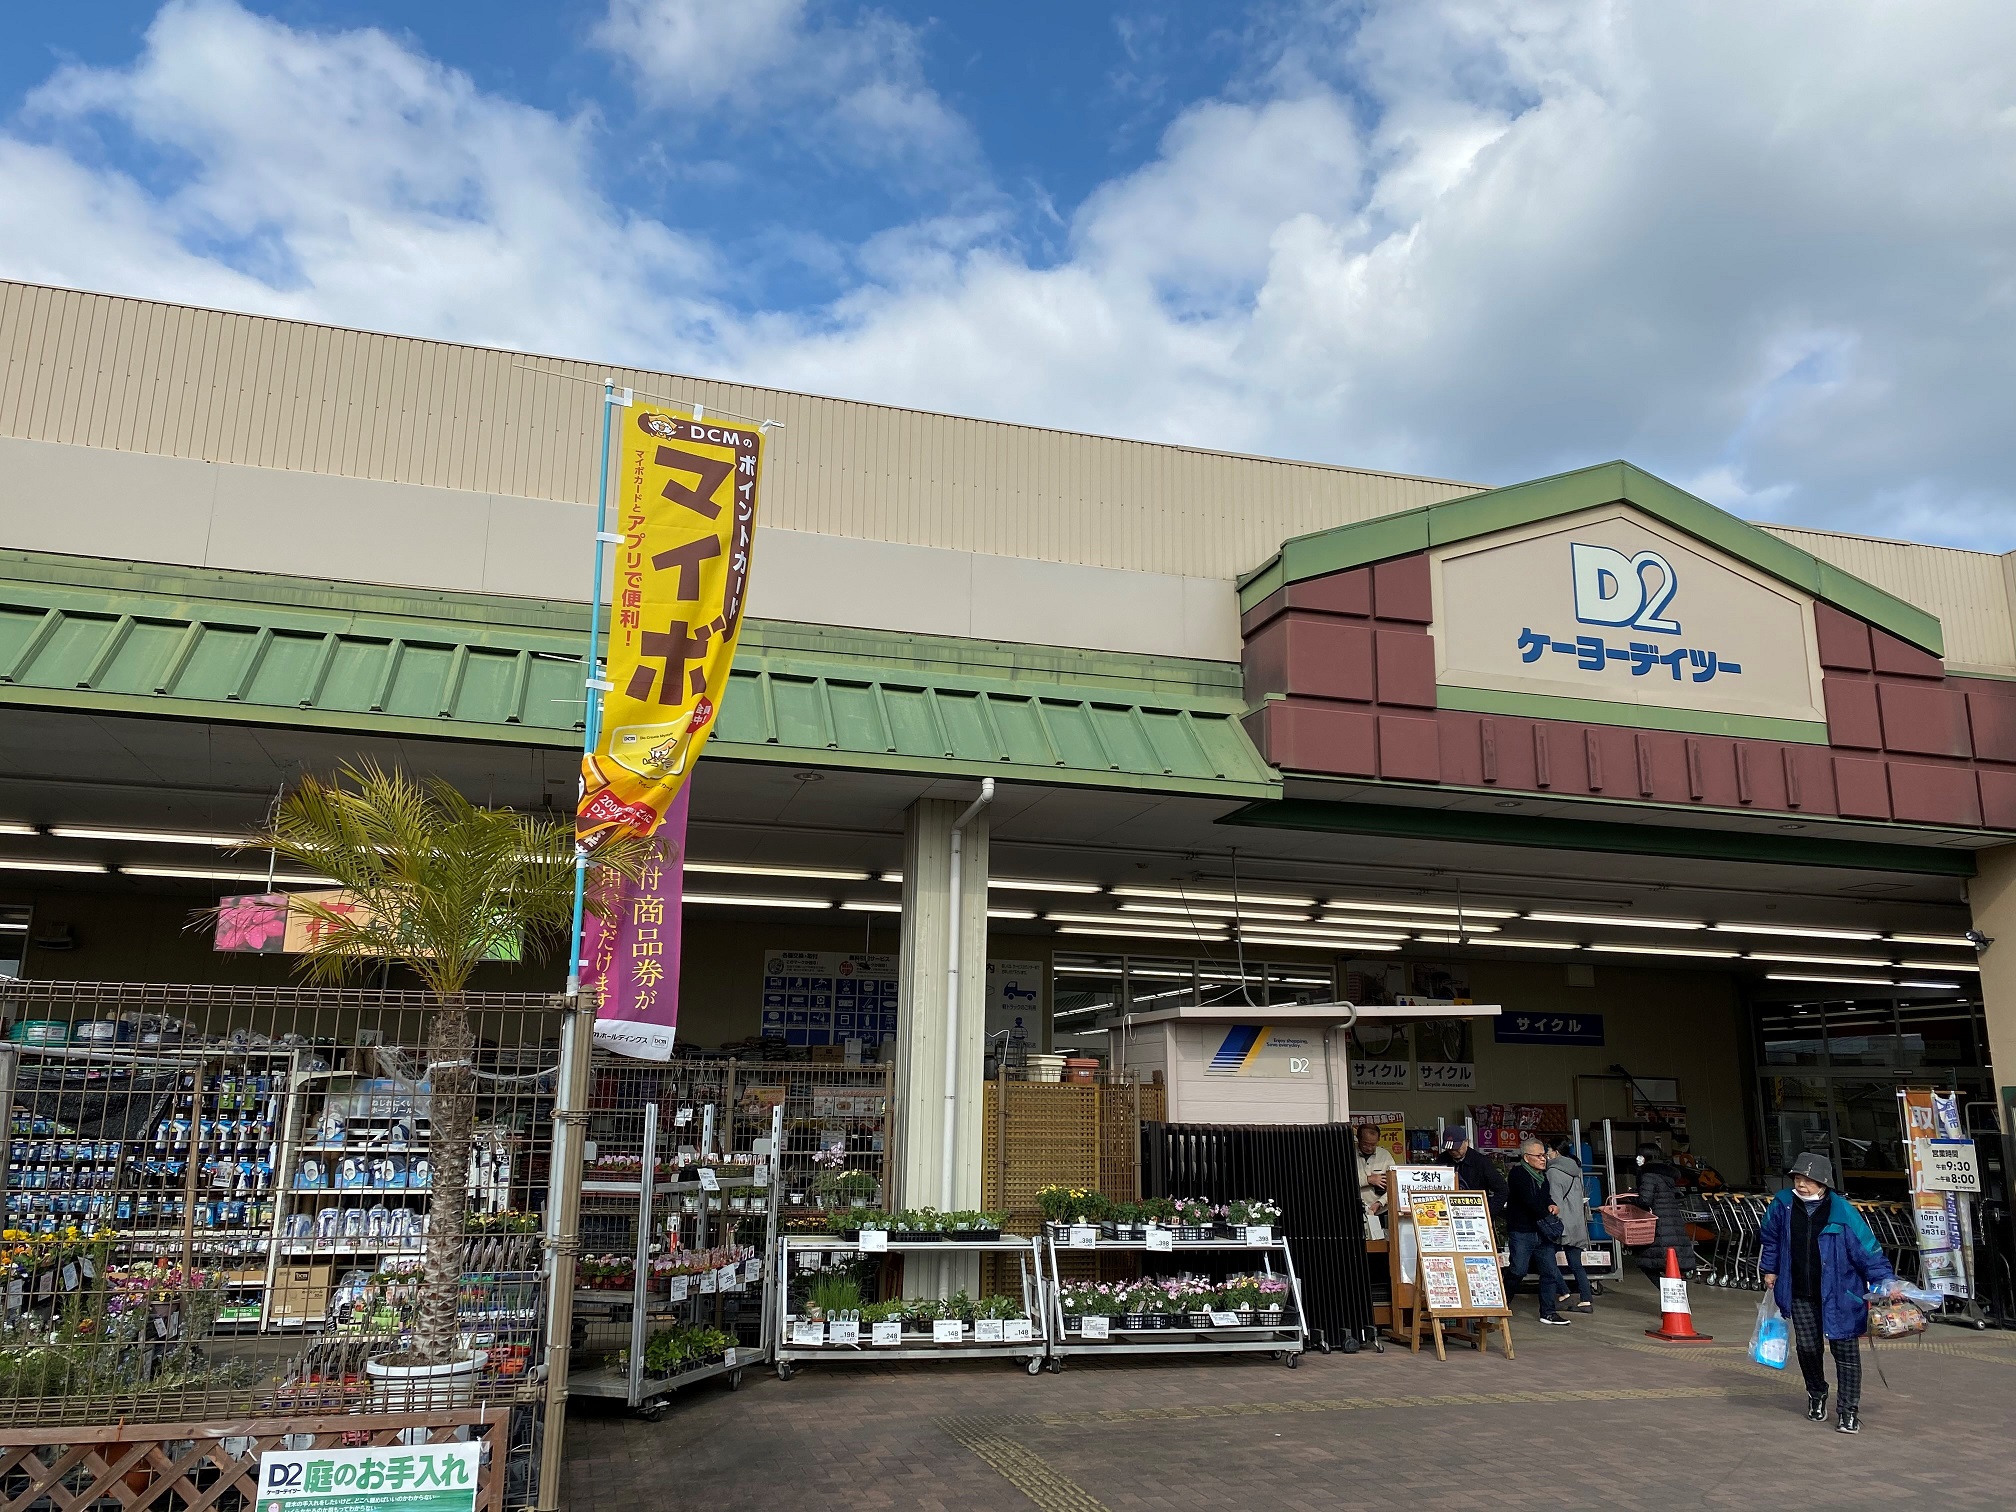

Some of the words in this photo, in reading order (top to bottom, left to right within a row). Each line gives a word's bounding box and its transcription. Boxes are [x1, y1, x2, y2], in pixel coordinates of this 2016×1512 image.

[724, 455, 757, 620] ポイントカード
[1570, 542, 1682, 636] D2
[1517, 627, 1742, 683] ケーヨーデイツー
[1516, 1017, 1582, 1032] サイクル
[1289, 1057, 1310, 1073] D2
[1354, 1063, 1406, 1078] サイクル
[1420, 1065, 1471, 1080] サイクル
[1931, 1149, 1959, 1158] 営業時間
[1935, 1160, 1971, 1172] 午前9:30
[1411, 1171, 1441, 1183] ご案内
[1920, 1214, 1945, 1222] 10月1日
[1920, 1228, 1946, 1236] 3月31日
[268, 1462, 303, 1488] D2
[302, 1453, 470, 1494] 庭のお手入れ
